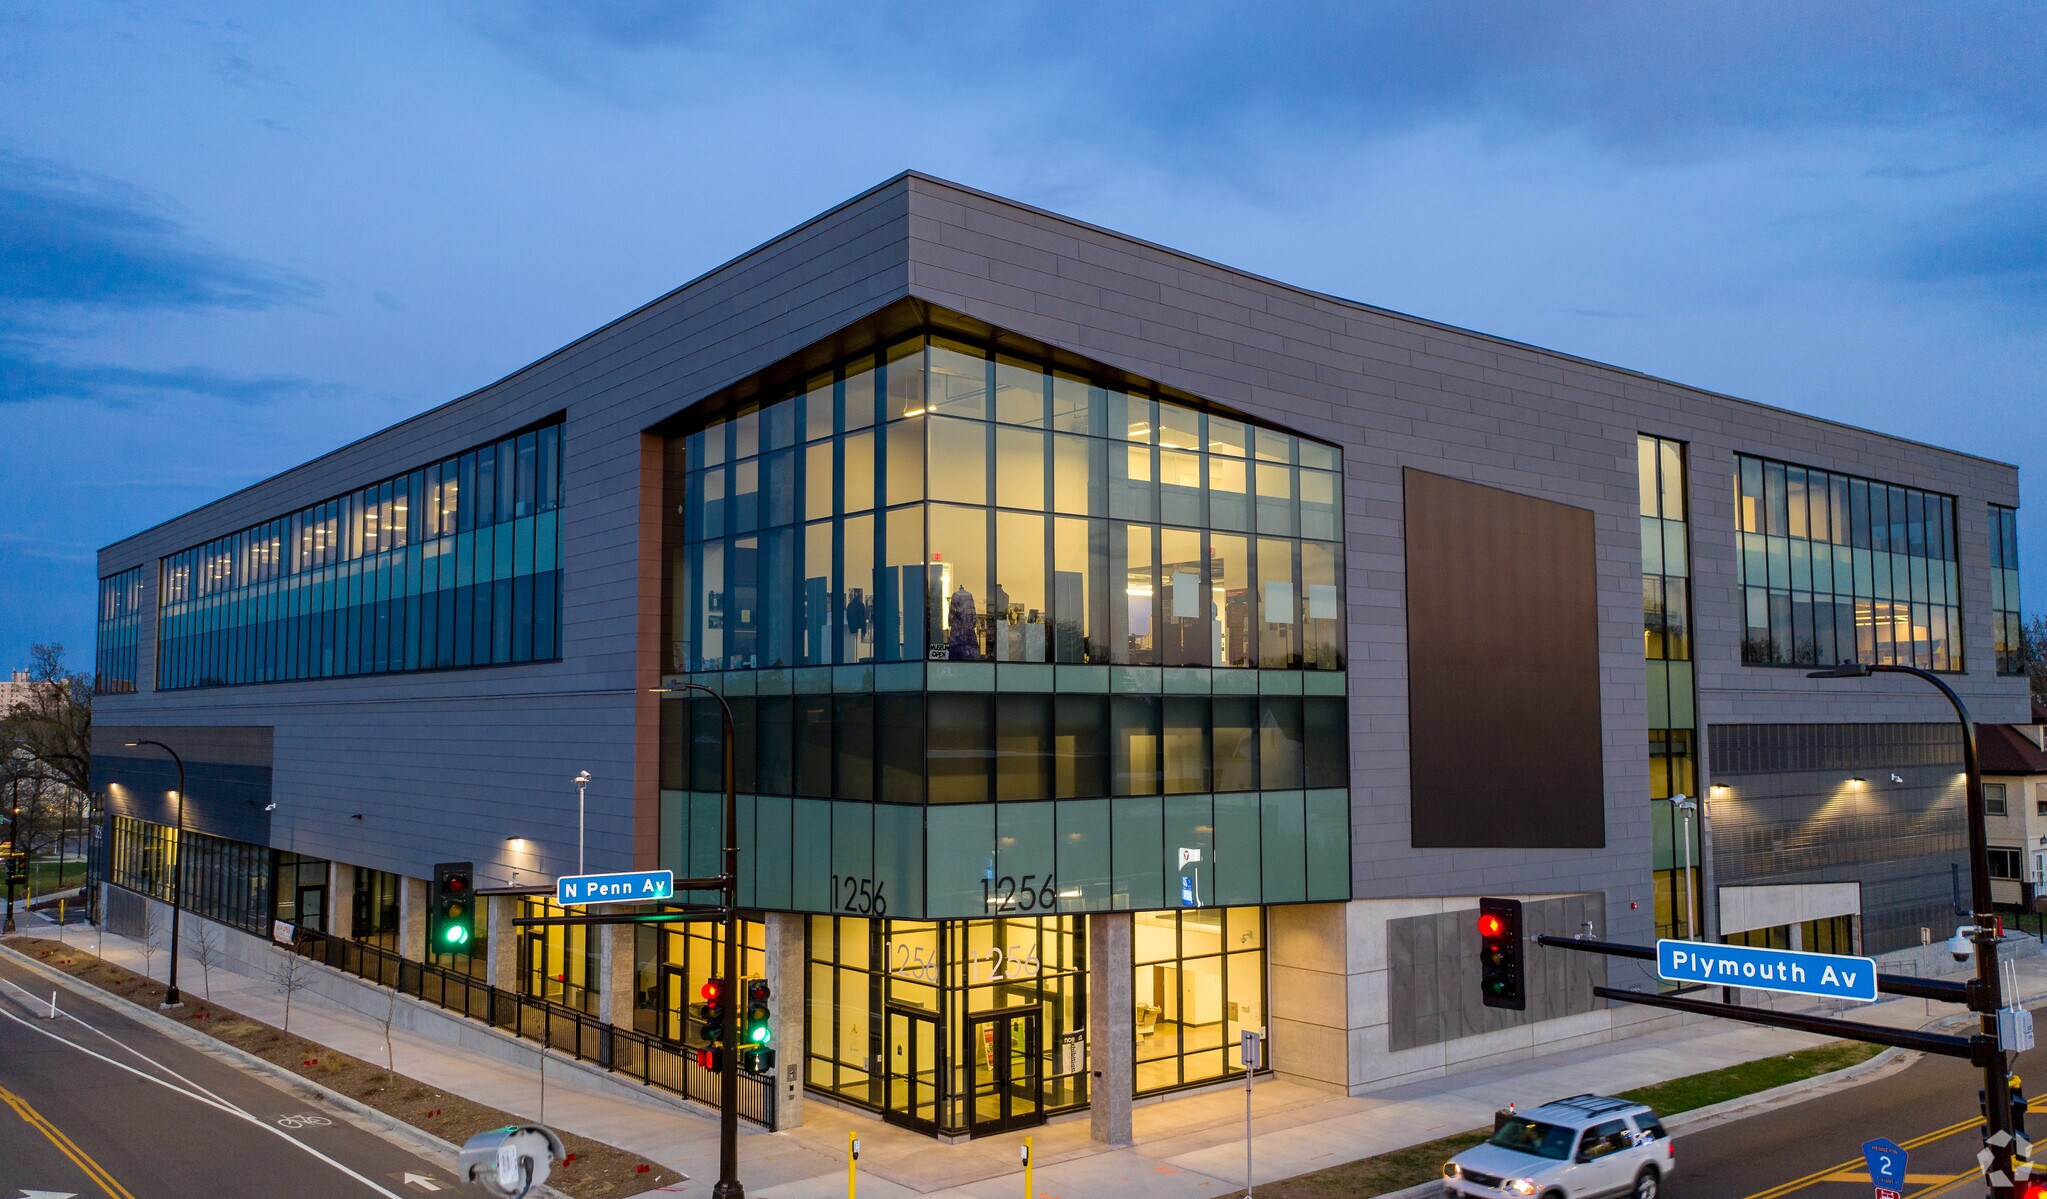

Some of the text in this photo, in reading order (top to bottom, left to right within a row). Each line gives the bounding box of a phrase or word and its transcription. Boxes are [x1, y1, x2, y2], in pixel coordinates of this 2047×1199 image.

[565, 878, 665, 898] N Penn Av
[832, 874, 887, 917] 1256
[981, 874, 1057, 914] 1256
[886, 941, 939, 982] 1256
[971, 943, 1040, 983] 1256
[1672, 950, 1857, 988] Plymouth Av
[1880, 1155, 1892, 1176] 2
